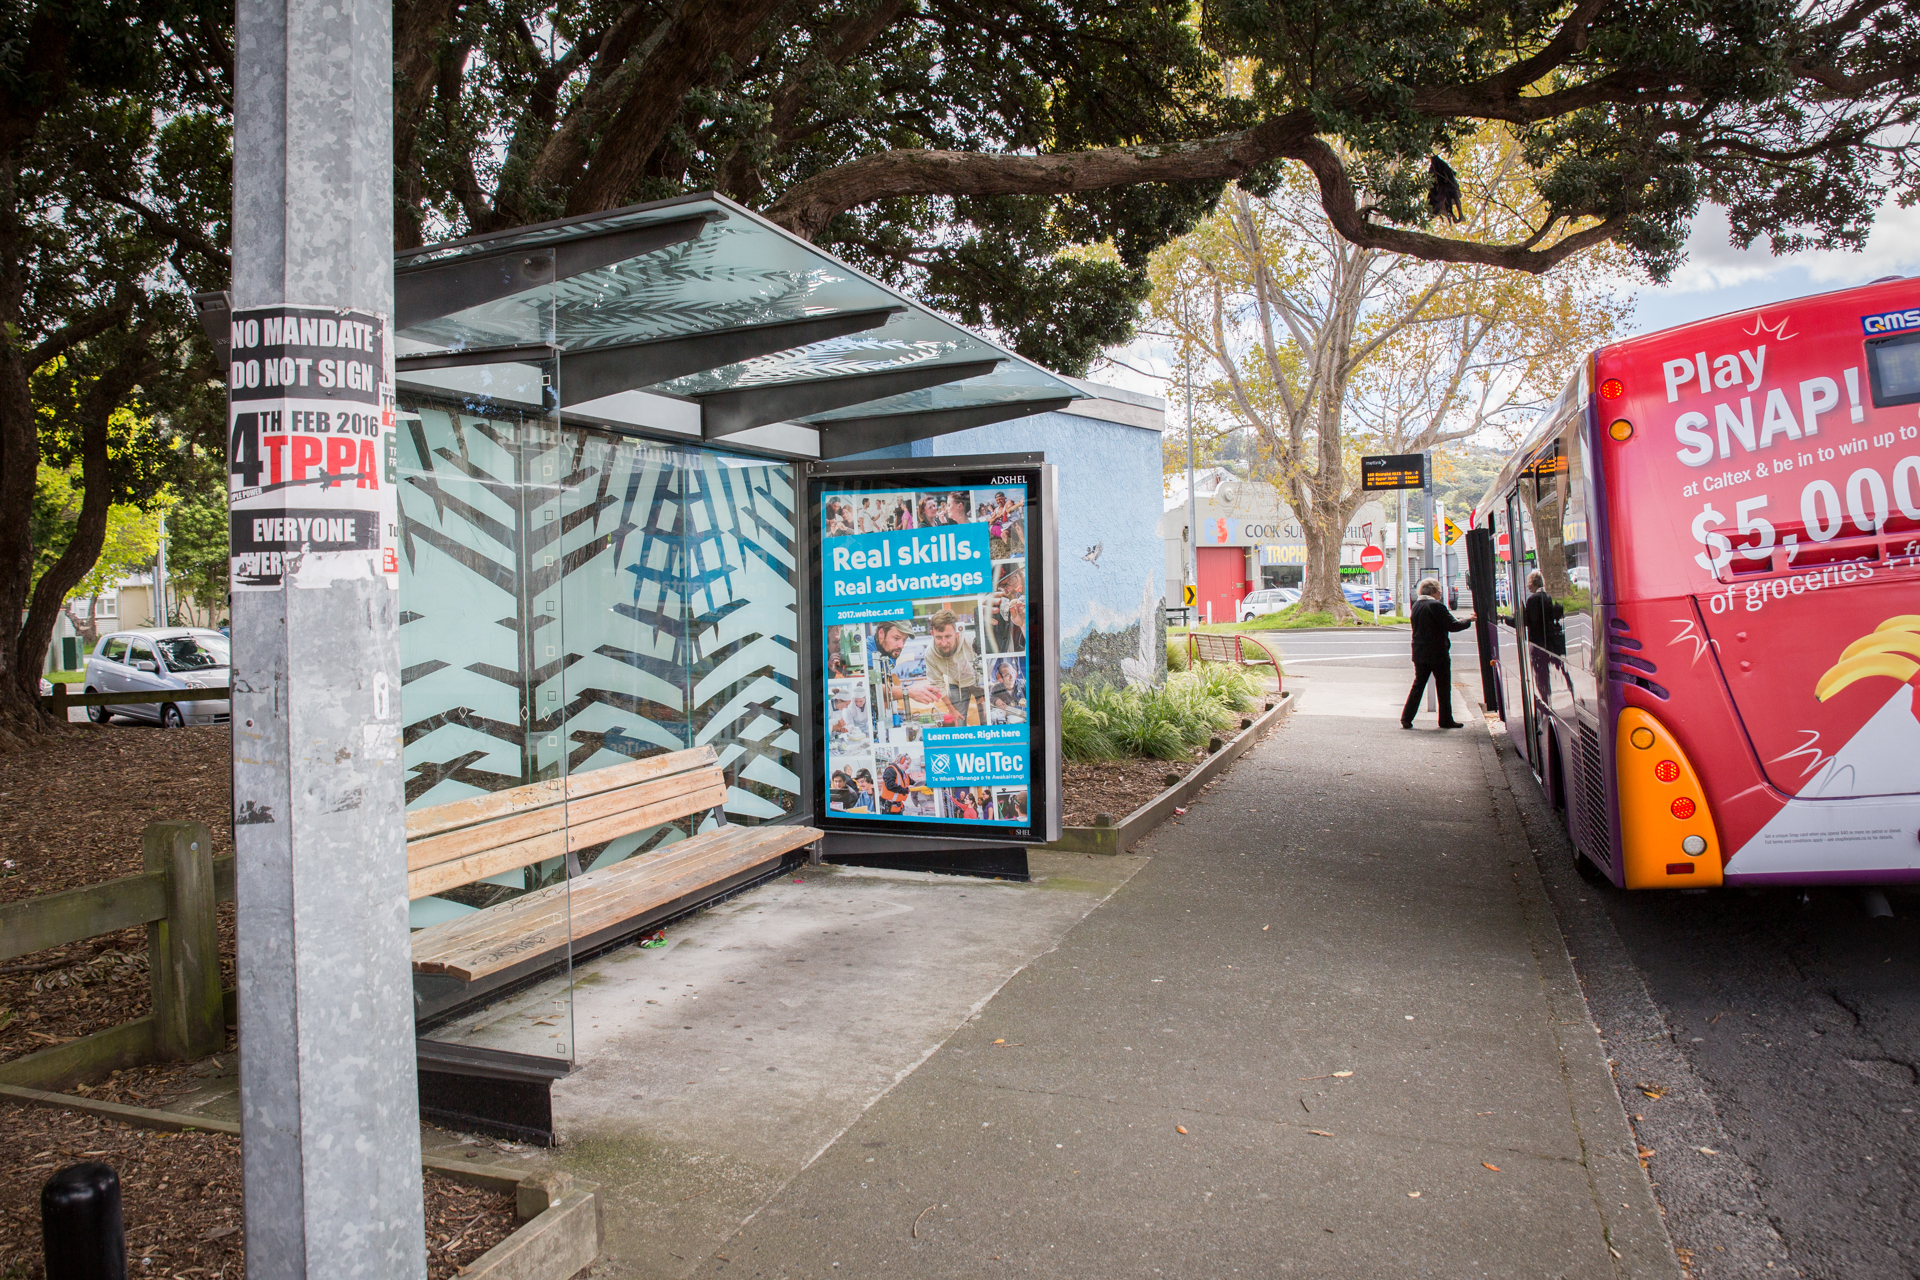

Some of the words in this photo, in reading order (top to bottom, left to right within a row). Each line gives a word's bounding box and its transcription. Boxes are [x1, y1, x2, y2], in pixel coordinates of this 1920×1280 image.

[232, 319, 258, 349] NO
[263, 316, 374, 352] MANDATE
[1864, 310, 1920, 333] QMS
[232, 360, 259, 389] DO
[265, 357, 312, 387] NOT
[318, 359, 374, 392] SIGN
[1662, 344, 1767, 403] Play
[292, 411, 331, 433] FEB
[336, 412, 379, 437] 2016
[1674, 366, 1864, 468] SNAP!
[263, 434, 380, 490] TPPA
[1682, 480, 1699, 498] at
[1703, 468, 1752, 492] Caltex
[1755, 461, 1769, 478] &
[1773, 455, 1793, 475] be
[1798, 451, 1814, 468] in
[1817, 446, 1835, 463] to
[1839, 436, 1869, 457] win
[1873, 430, 1895, 450] up
[1898, 424, 1918, 441] to
[243, 487, 263, 498] POWER
[990, 475, 1028, 485] ADSHEL
[253, 517, 356, 542] EVERYONE
[1244, 524, 1280, 538] COOK
[832, 539, 891, 571] Real
[898, 533, 981, 566] skills.
[834, 576, 871, 596] Real
[875, 571, 983, 594] advantages
[1709, 585, 1736, 615] of
[1745, 556, 1875, 612] groceries
[837, 607, 905, 620] 2017.weltec.ac.nz
[927, 733, 950, 741] Learn
[952, 732, 976, 740] more.
[977, 730, 1000, 740] Right
[1001, 729, 1020, 738] here
[955, 751, 1023, 774] WelTec
